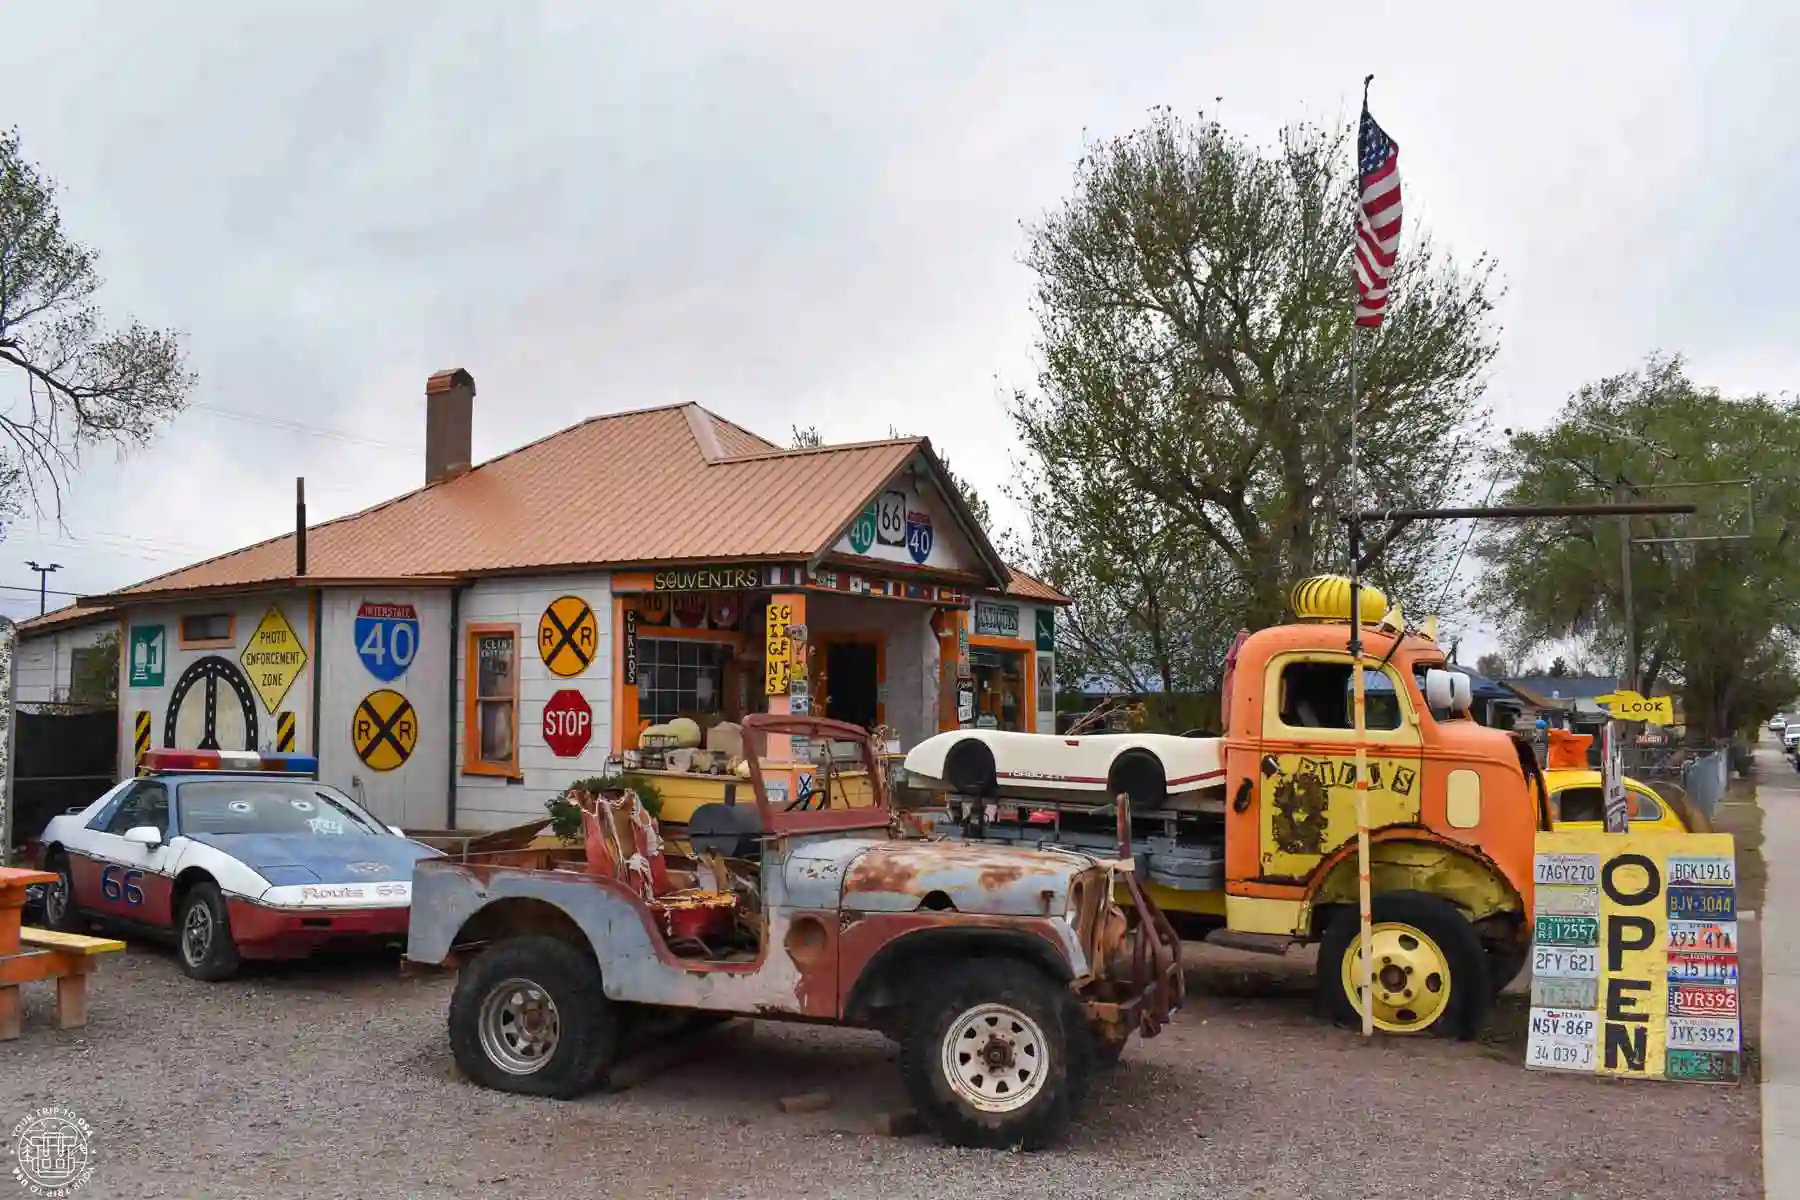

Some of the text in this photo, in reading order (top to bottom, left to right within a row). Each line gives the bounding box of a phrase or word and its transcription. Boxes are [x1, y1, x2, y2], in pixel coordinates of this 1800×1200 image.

[882, 503, 901, 532] 66
[851, 520, 872, 546] 40
[910, 530, 930, 555] 40
[655, 569, 757, 590] SOUVENIRS
[364, 607, 411, 618] INTERSTATE
[260, 630, 288, 644] PHOTO
[359, 622, 414, 666] 40
[627, 610, 637, 683] CURIOS
[246, 652, 300, 665] ENFORCEMENT
[262, 673, 283, 687] ZONE
[1621, 702, 1663, 712] LOOK
[545, 710, 590, 736] STOP
[1537, 864, 1595, 881] 7AGY270
[1675, 863, 1731, 880] BGK1916
[102, 863, 145, 908] 66
[1556, 923, 1596, 939] 12557
[1601, 853, 1661, 1071] OPEN
